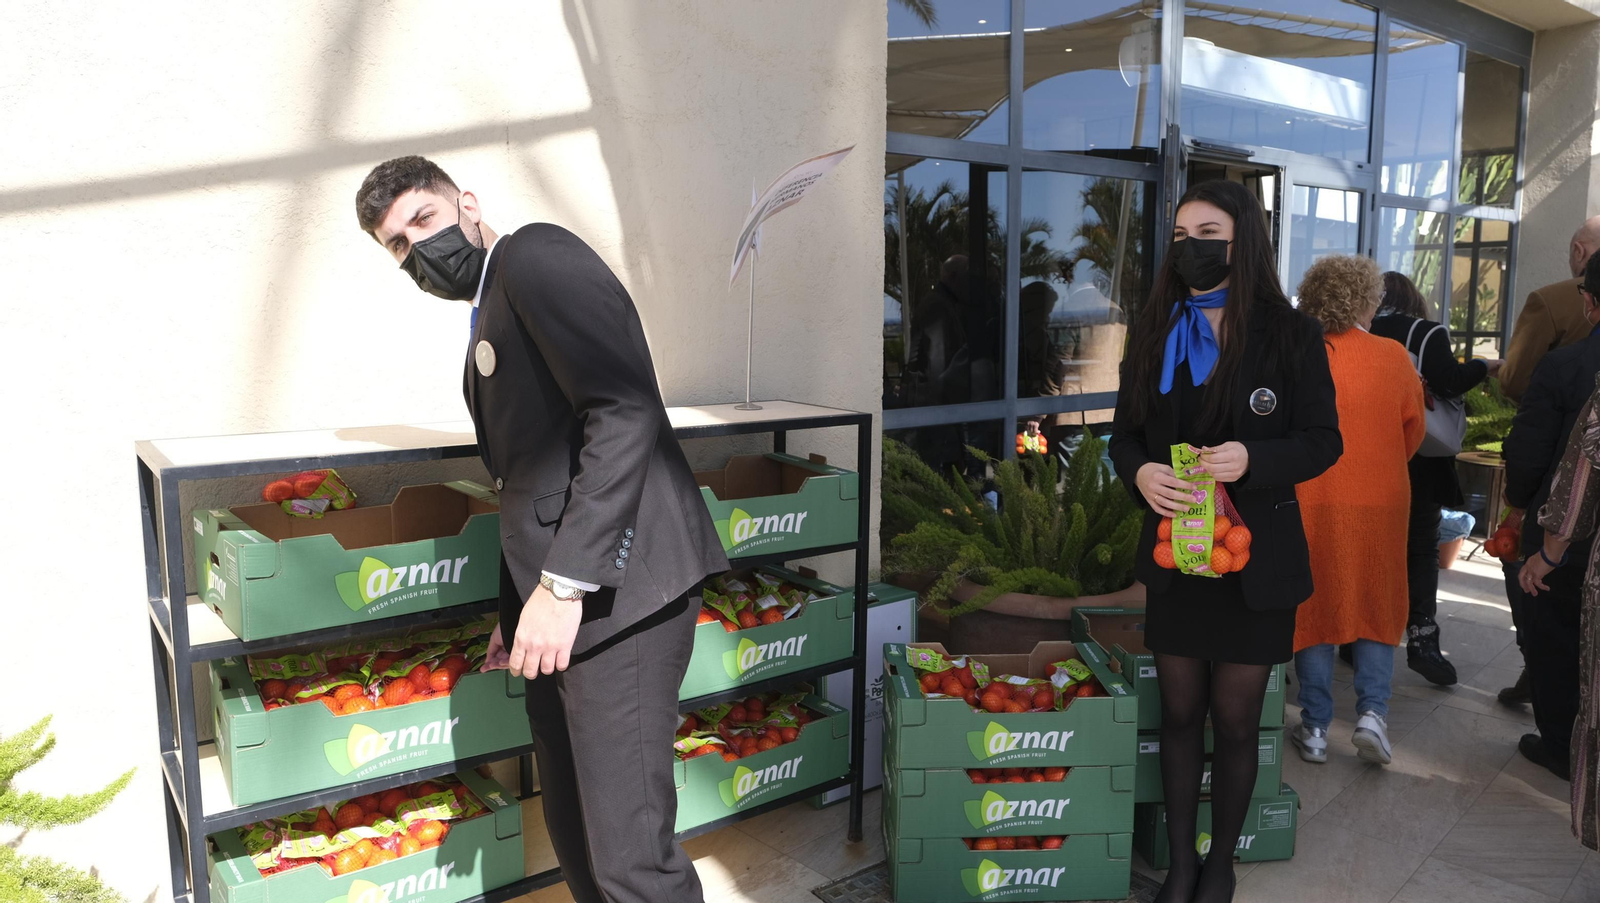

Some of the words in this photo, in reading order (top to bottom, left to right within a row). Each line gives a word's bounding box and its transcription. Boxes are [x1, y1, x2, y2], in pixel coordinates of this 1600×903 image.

[734, 511, 808, 542] aznar
[734, 545, 750, 555] FRESH
[750, 538, 770, 547] SPANISH
[366, 555, 469, 599] aznar
[367, 601, 389, 615] FRESH
[390, 592, 418, 604] SPANISH
[420, 588, 438, 596] FRUIT
[741, 633, 808, 671] aznar
[355, 716, 459, 764] aznar
[988, 730, 1075, 754] aznar
[356, 764, 378, 778] FRESH
[379, 754, 407, 768] SPANISH
[410, 750, 428, 758] FRUIT
[989, 757, 1007, 766] FRESH
[737, 755, 804, 797] aznar
[986, 798, 1071, 822] aznar
[986, 825, 1003, 833] FRESH
[1200, 834, 1256, 854] aar
[356, 861, 455, 903] aznar
[982, 866, 1066, 890] aznar
[982, 893, 999, 901] FRESH
